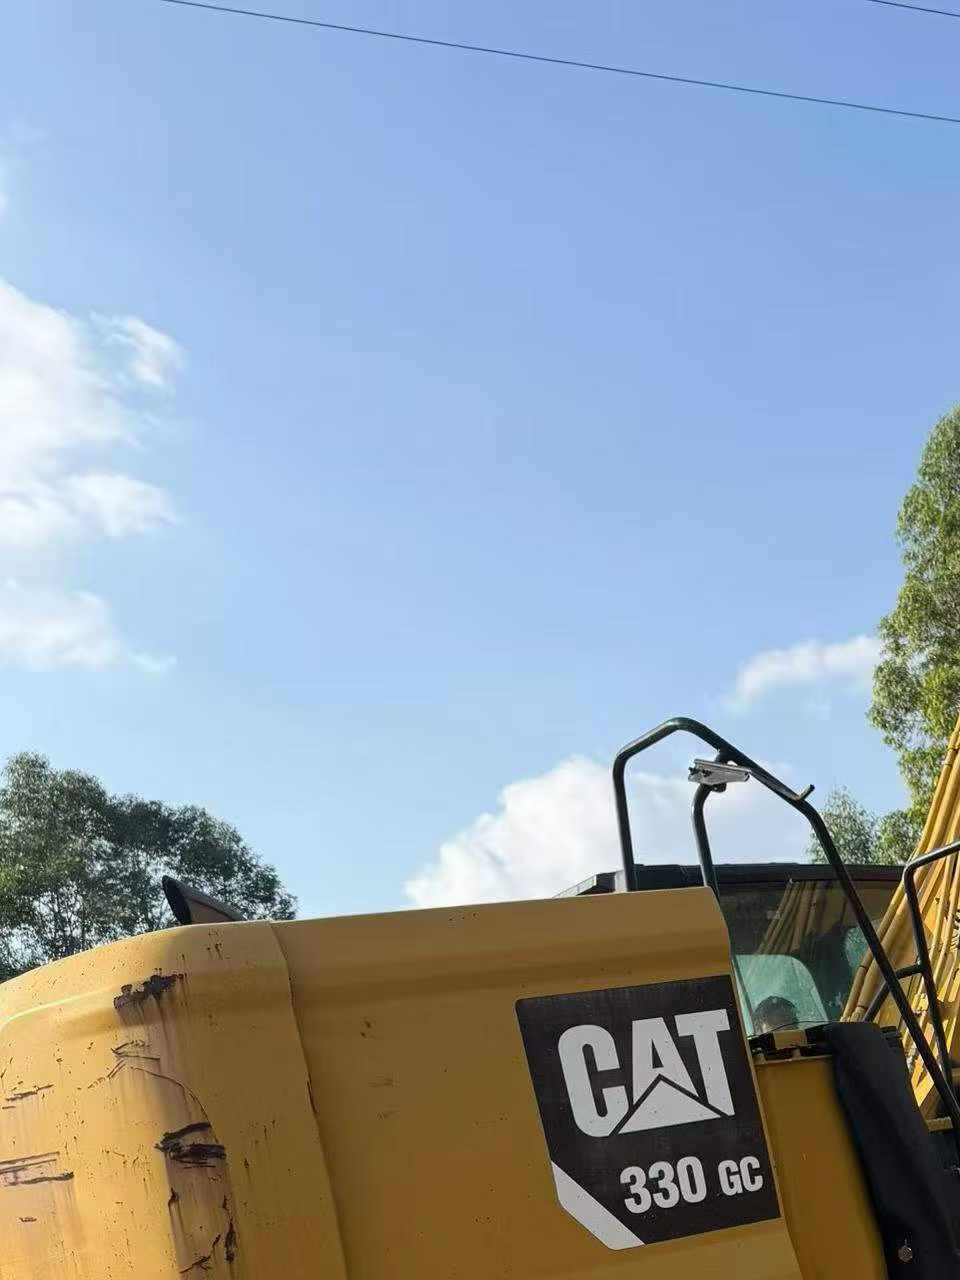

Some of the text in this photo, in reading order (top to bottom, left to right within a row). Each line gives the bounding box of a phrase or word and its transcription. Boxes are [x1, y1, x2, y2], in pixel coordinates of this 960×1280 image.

[558, 1009, 735, 1137] CAT
[619, 1156, 764, 1214] 330 GC
